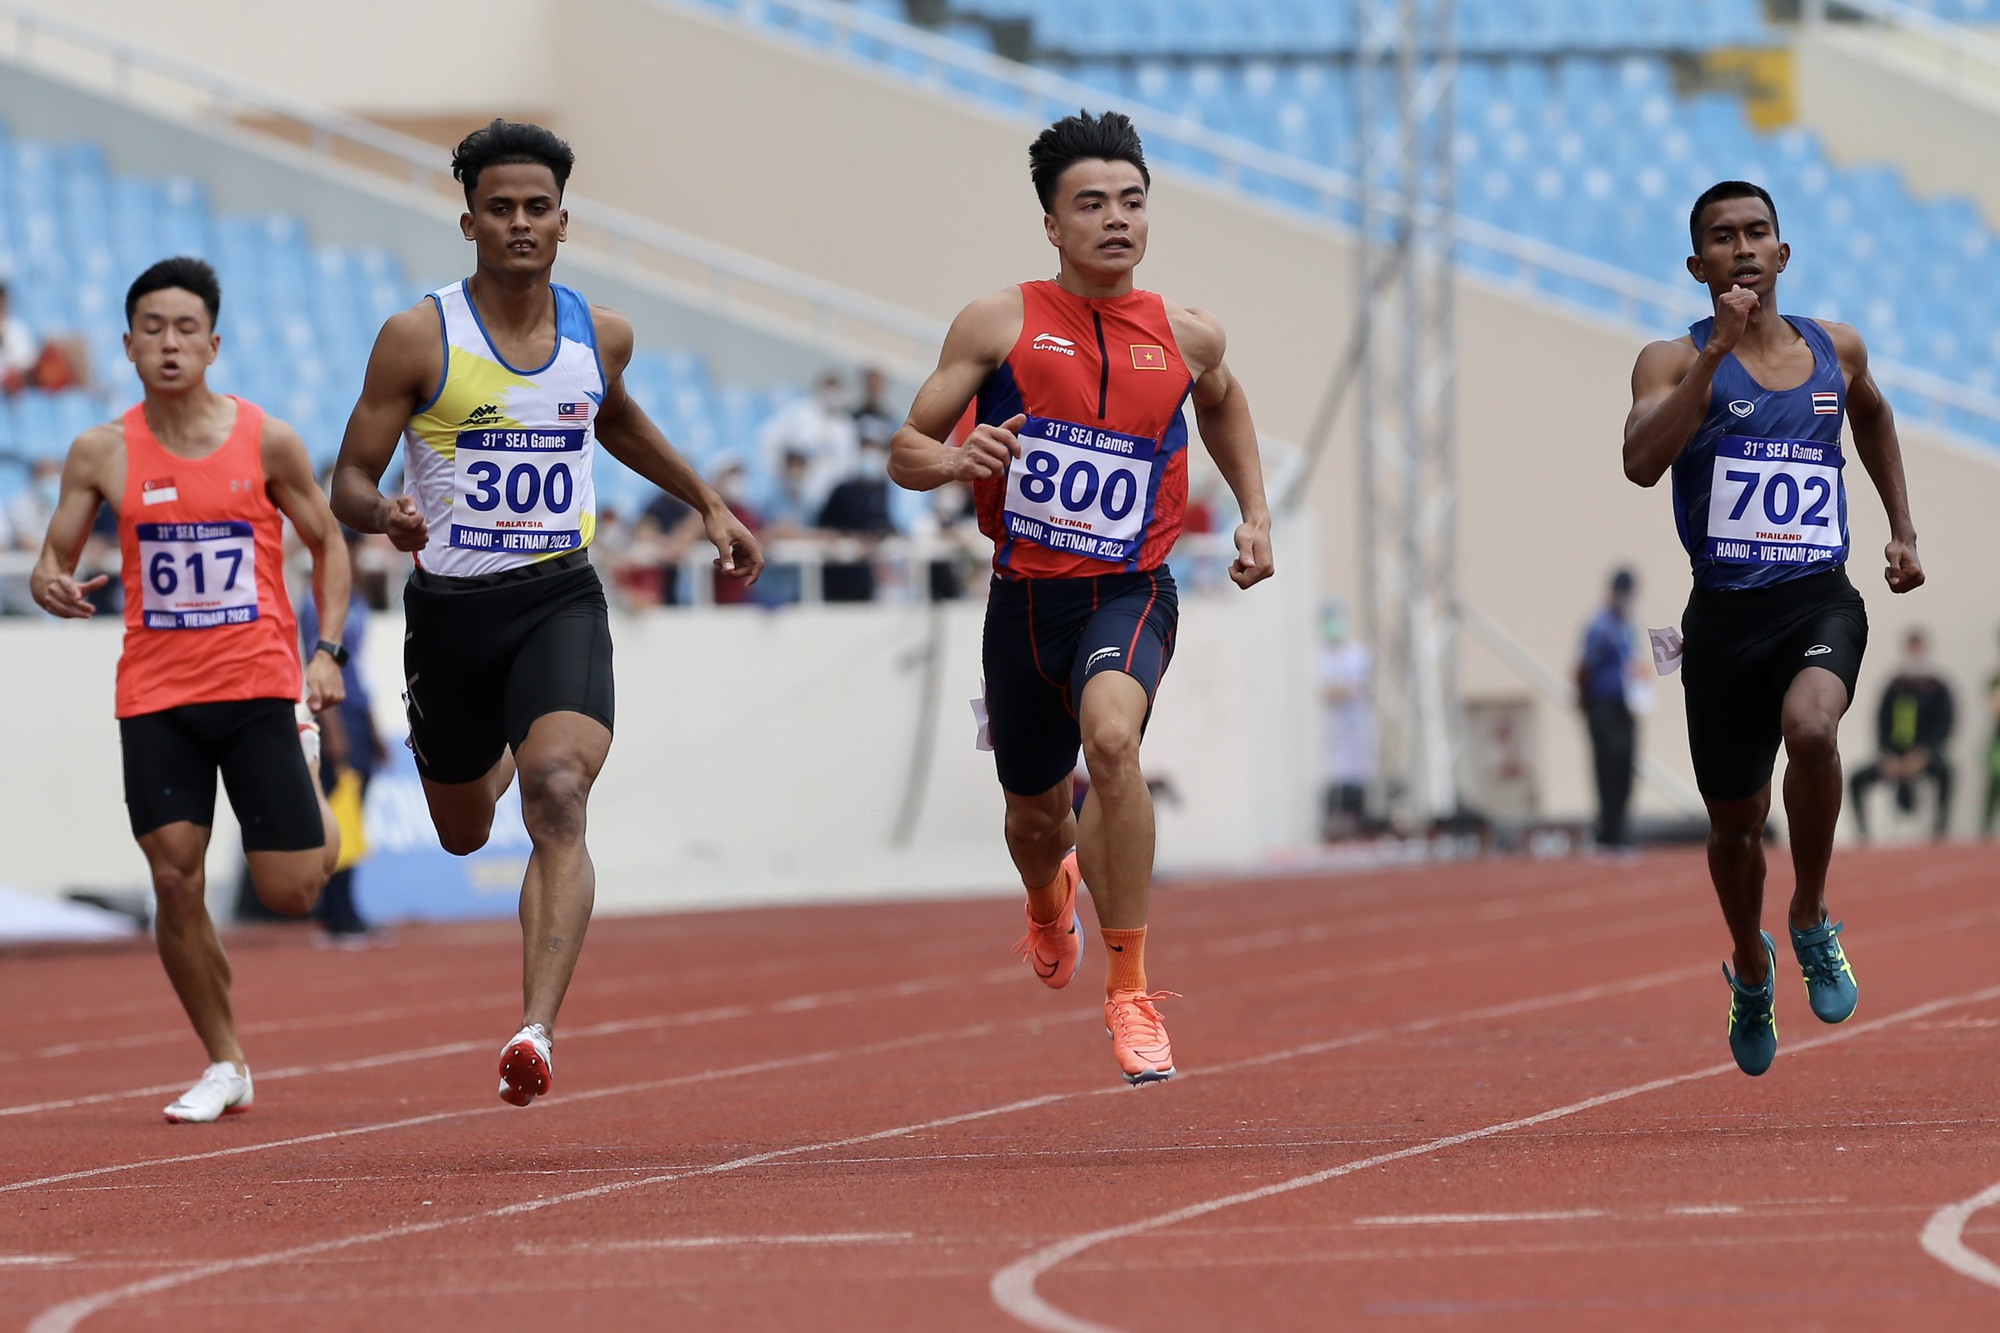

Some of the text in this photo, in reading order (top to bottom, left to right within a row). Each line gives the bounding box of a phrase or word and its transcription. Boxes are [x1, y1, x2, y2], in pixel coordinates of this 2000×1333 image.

[1032, 342, 1076, 356] LI-NING
[506, 433, 528, 448] SEA
[531, 433, 566, 448] Games
[1069, 426, 1092, 446] SEA
[1096, 432, 1134, 454] Games
[1766, 443, 1789, 458] SEA
[1792, 444, 1823, 462] Games
[465, 461, 572, 514] 300
[1020, 450, 1138, 521] 800
[1726, 470, 1832, 528] 702
[176, 526, 195, 539] SEA
[197, 525, 231, 539] Games
[496, 520, 543, 528] MALAYSIA
[1050, 516, 1092, 530] VIETNAM
[460, 530, 492, 547] HANOI
[502, 533, 549, 549] VIETNAM
[549, 534, 572, 549] 2022
[1011, 517, 1042, 540] HANOI
[1050, 530, 1097, 553] VIETNAM
[1097, 541, 1124, 558] 2022
[1755, 532, 1802, 541] THAILAND
[1716, 542, 1750, 559] HANOI
[1760, 545, 1807, 562] VIETNAM
[149, 548, 242, 596] 617
[183, 611, 226, 627] VIETNAM
[227, 607, 251, 624] 2022
